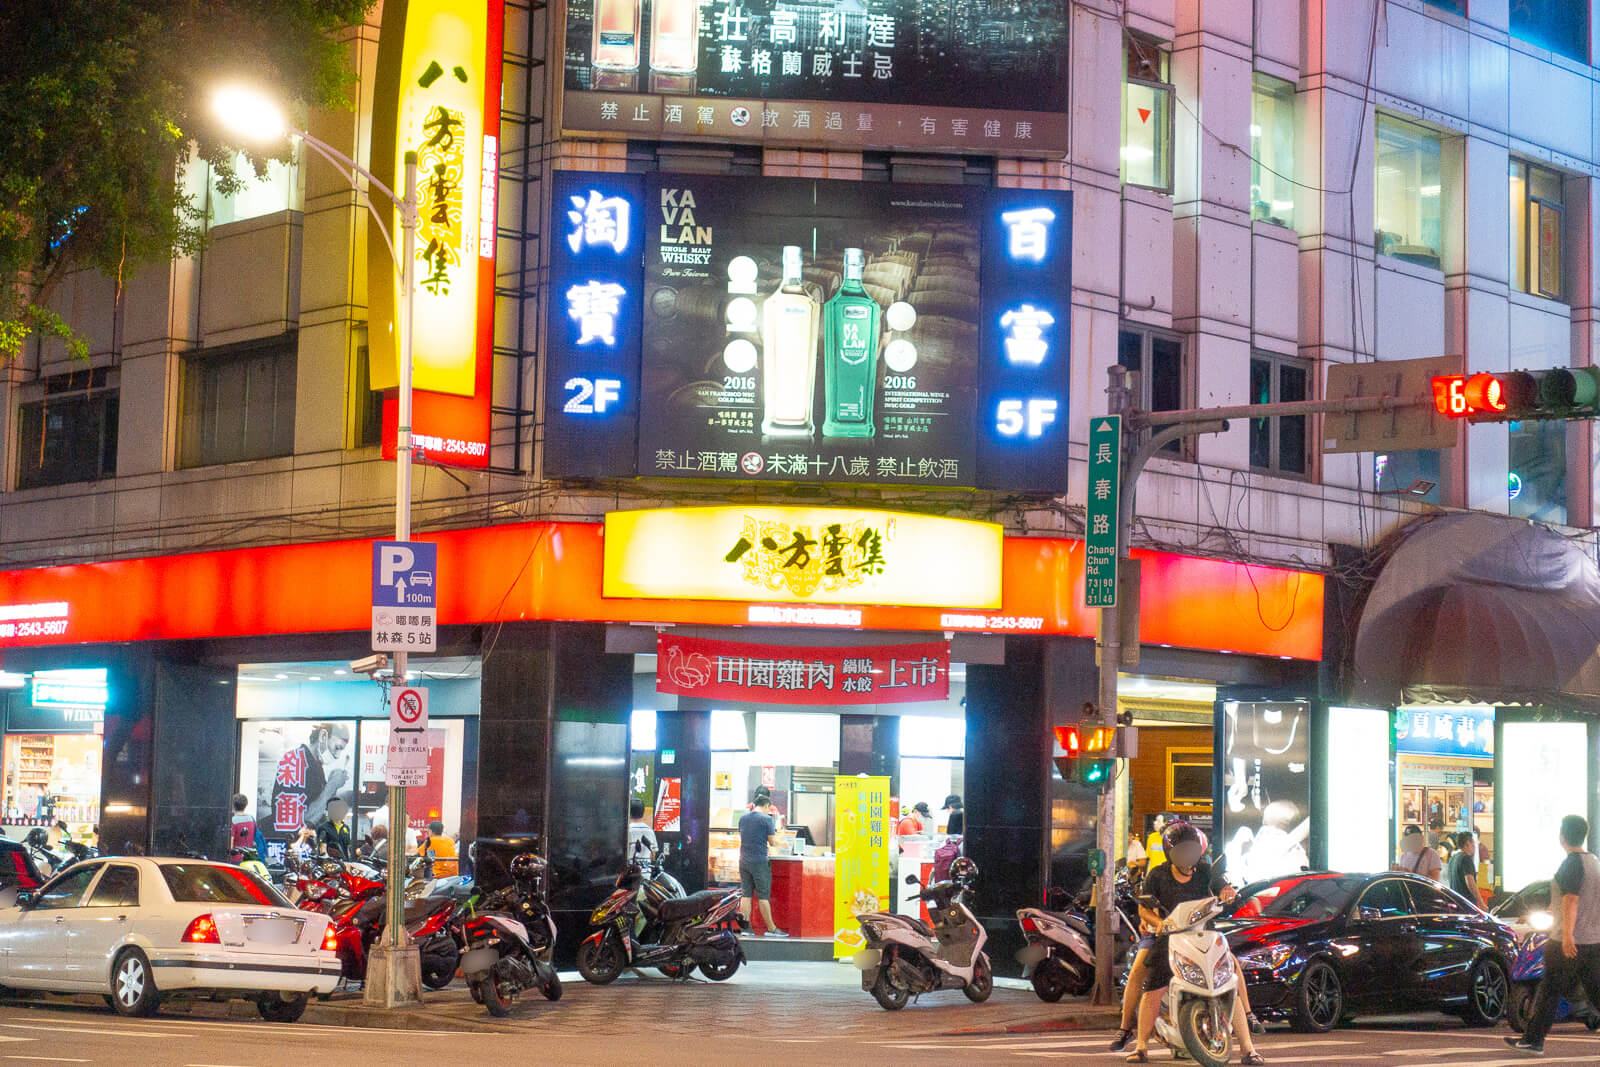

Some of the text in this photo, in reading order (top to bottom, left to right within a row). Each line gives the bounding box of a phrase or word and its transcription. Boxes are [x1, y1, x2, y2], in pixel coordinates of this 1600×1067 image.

[718, 6, 896, 48] 仕高利達
[720, 45, 893, 80] 蘇格蘭威士忌
[600, 102, 715, 126] 禁止酒駕
[418, 60, 468, 296] 八方雲集
[661, 188, 696, 208] KA
[661, 208, 696, 226] VA
[661, 226, 713, 245] LAN
[660, 252, 712, 265] WHISKY
[996, 208, 1057, 436] 百富 5F
[724, 376, 756, 390] 2016
[884, 376, 916, 390] 2016
[563, 377, 621, 414] 2F
[656, 449, 959, 479] 禁止酒駕 未滿十八歲 禁止飲酒
[1092, 443, 1112, 534] 長春路
[725, 523, 886, 577] 八方雲集
[1087, 545, 1115, 556] Chang
[380, 545, 415, 586] P
[1087, 556, 1109, 565] Chun
[1088, 578, 1113, 587] 73 90
[406, 594, 432, 603] 100m
[1087, 595, 1097, 604] 31
[395, 615, 432, 627] 嘟嘟房
[376, 631, 432, 645] 林森5站
[717, 655, 835, 690] 田園雞肉
[842, 657, 873, 675] 鍋貼
[879, 656, 939, 689] 上市
[842, 676, 873, 693] 水餃
[870, 791, 882, 848] 田園雞肉
